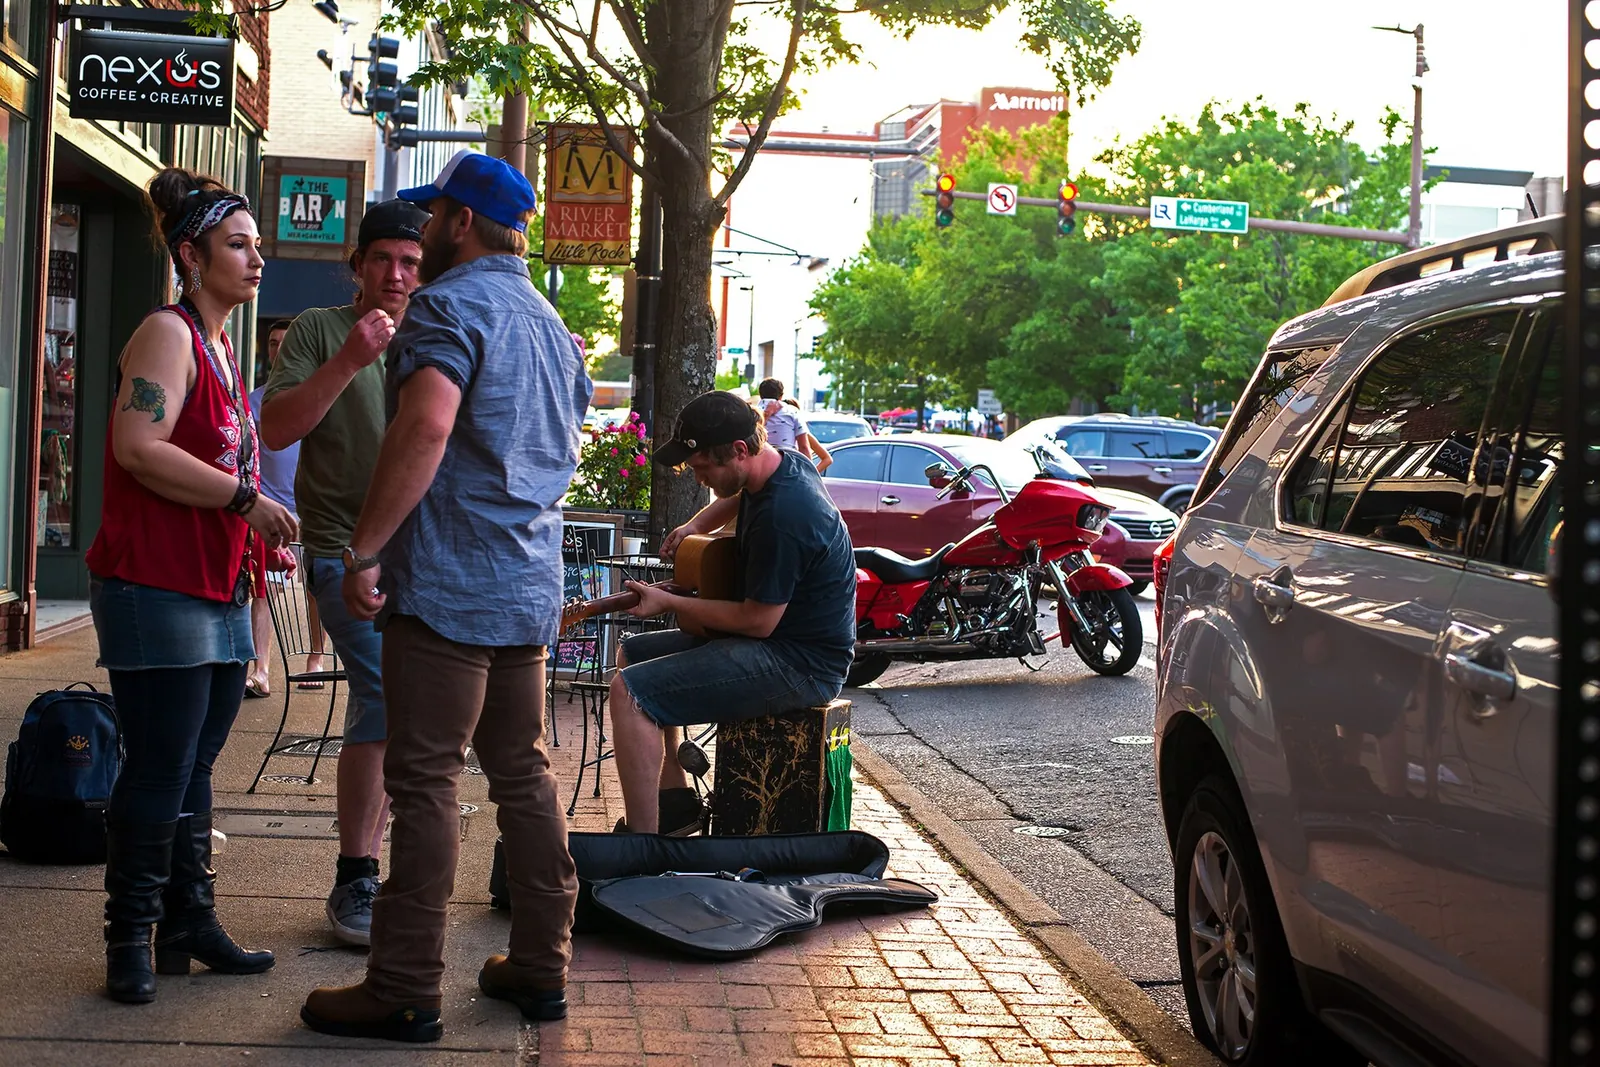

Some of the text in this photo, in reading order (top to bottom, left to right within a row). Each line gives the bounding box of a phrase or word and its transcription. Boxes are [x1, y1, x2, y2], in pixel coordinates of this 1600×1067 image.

[79, 50, 221, 89] nexus
[79, 87, 224, 107] COFFEE CREATIVE
[988, 92, 1064, 112] Marriott
[308, 181, 329, 192] THE
[560, 206, 616, 222] RIVER
[1192, 202, 1234, 216] Cumberland
[549, 222, 628, 238] MARKET
[549, 242, 626, 263] Little Rock
